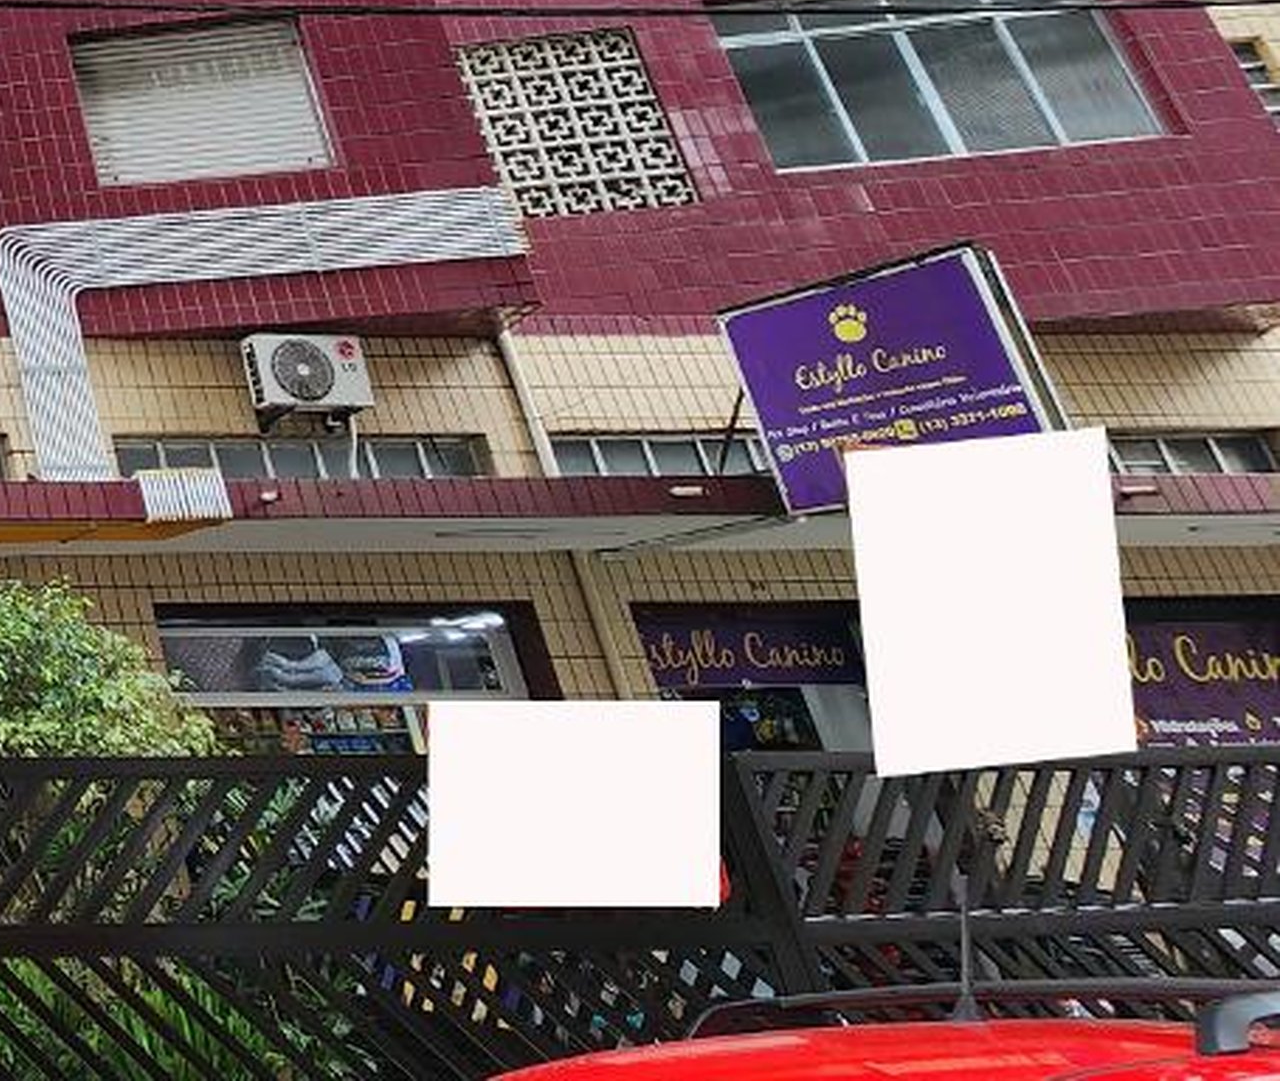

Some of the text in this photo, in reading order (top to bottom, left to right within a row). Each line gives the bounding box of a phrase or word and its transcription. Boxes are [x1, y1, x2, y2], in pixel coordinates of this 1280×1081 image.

[795, 344, 947, 393] Estyllo Canino
[649, 630, 845, 685] styllo Canino
